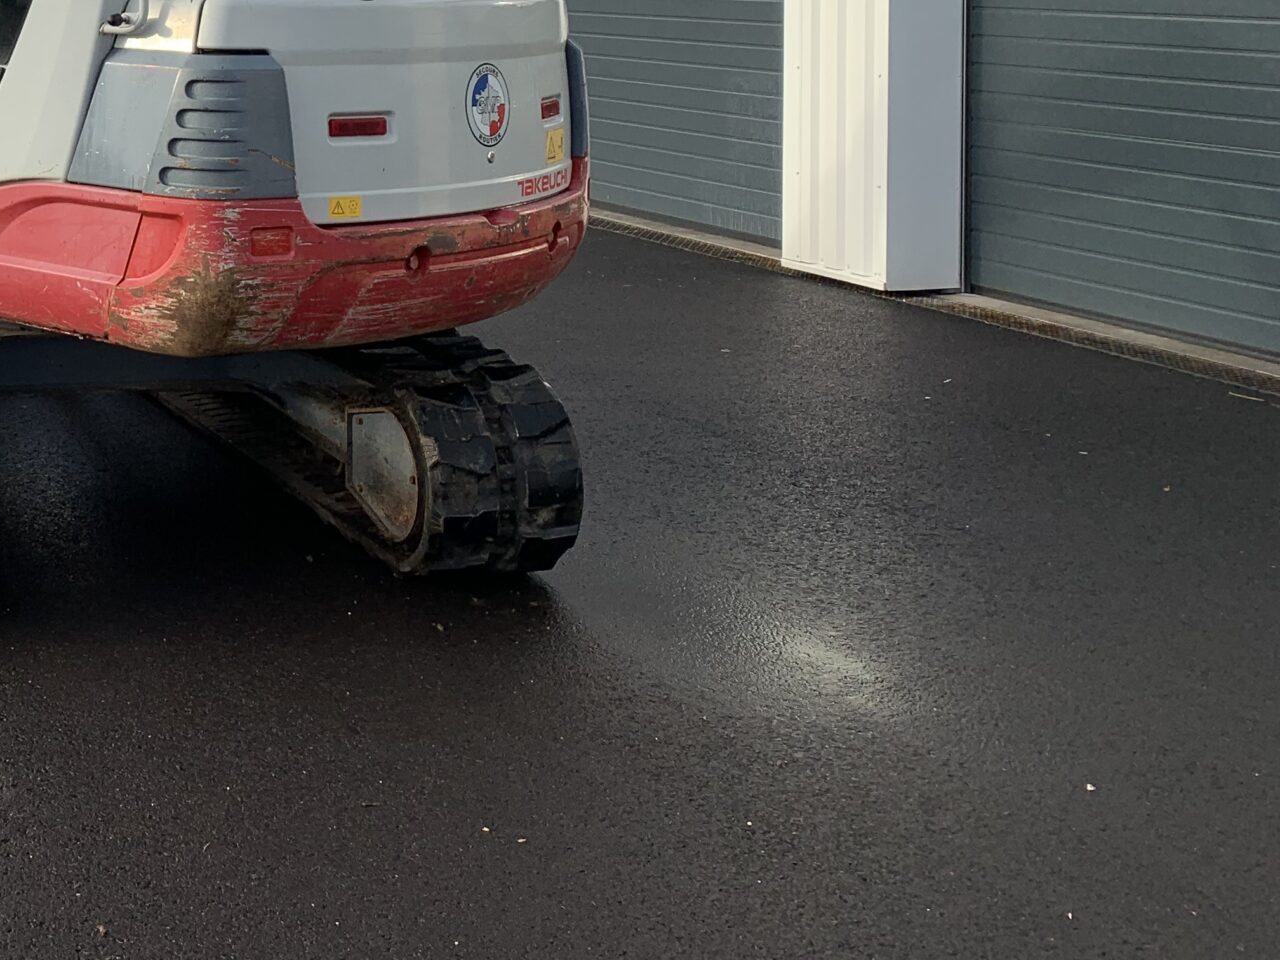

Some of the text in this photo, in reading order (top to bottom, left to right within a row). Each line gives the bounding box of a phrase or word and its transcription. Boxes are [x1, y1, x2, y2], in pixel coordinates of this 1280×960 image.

[475, 66, 499, 79] SECOURS
[478, 133, 502, 144] ROUTIER
[517, 168, 569, 197] TAKEUCHI
